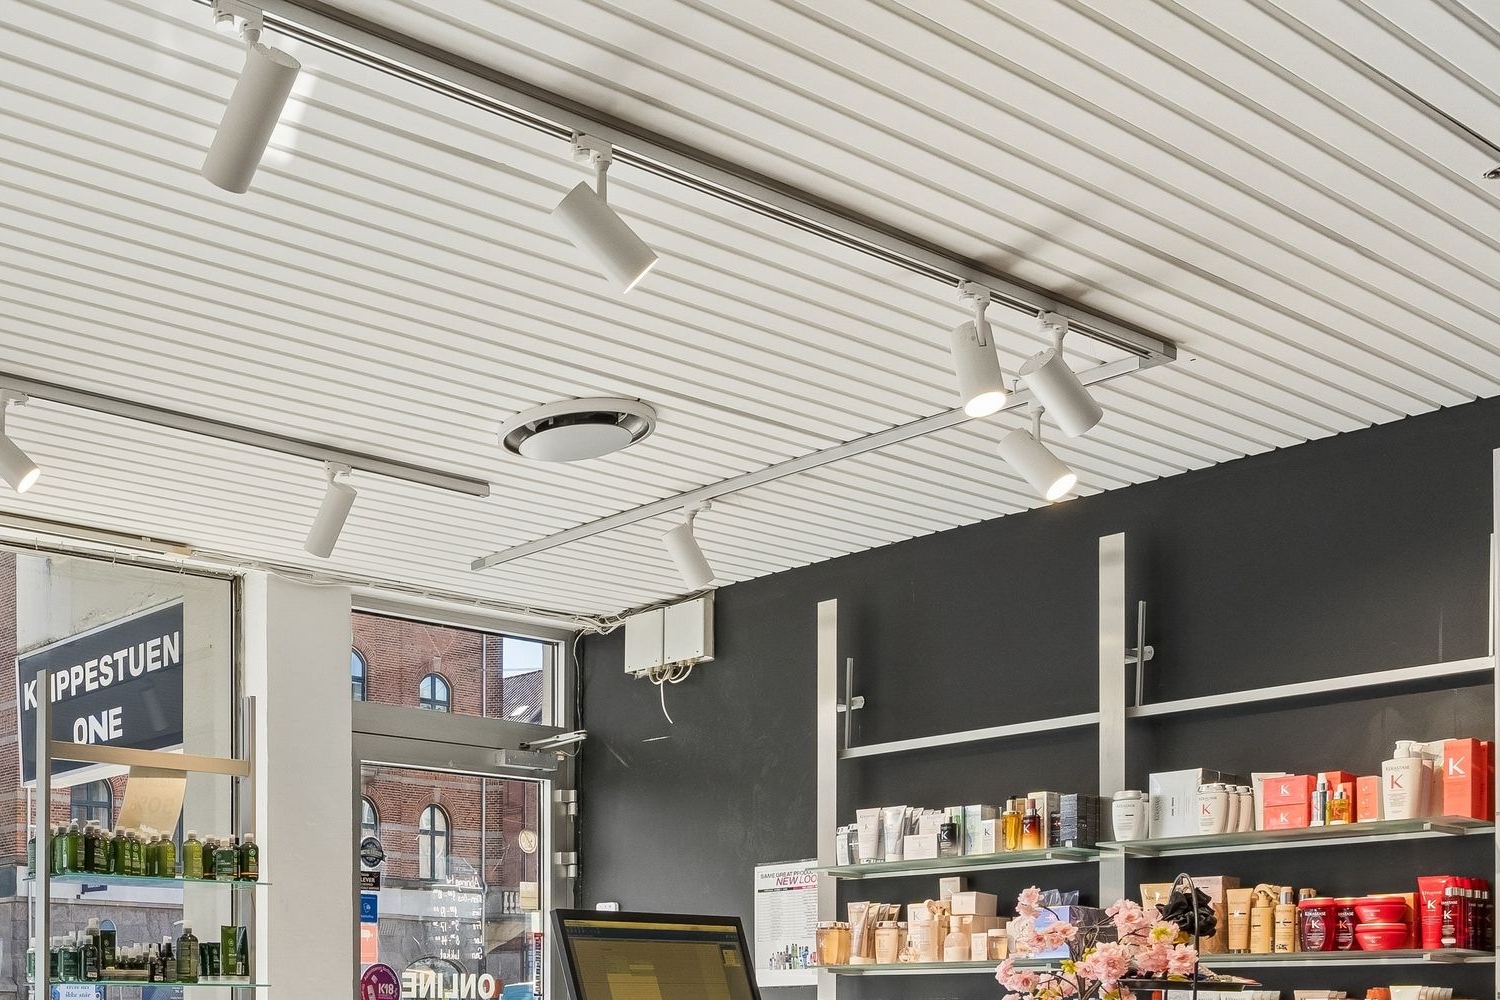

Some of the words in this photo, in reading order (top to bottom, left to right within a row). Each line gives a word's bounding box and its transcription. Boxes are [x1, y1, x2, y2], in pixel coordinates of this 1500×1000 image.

[24, 631, 180, 711] KIPPESTUEN
[73, 706, 123, 744] ONE
[1448, 756, 1465, 776] K
[1390, 775, 1404, 789] K
[1280, 785, 1290, 796] K
[1202, 804, 1211, 814] K
[1280, 813, 1290, 823] K
[941, 830, 948, 839] K
[984, 828, 990, 836] K
[1024, 825, 1030, 834] K
[776, 877, 798, 886] NEW
[800, 874, 817, 884] LOO
[1427, 900, 1436, 909] K
[1443, 910, 1452, 919] K
[1311, 920, 1319, 928] K
[1339, 920, 1347, 928] K
[378, 983, 394, 995] K18
